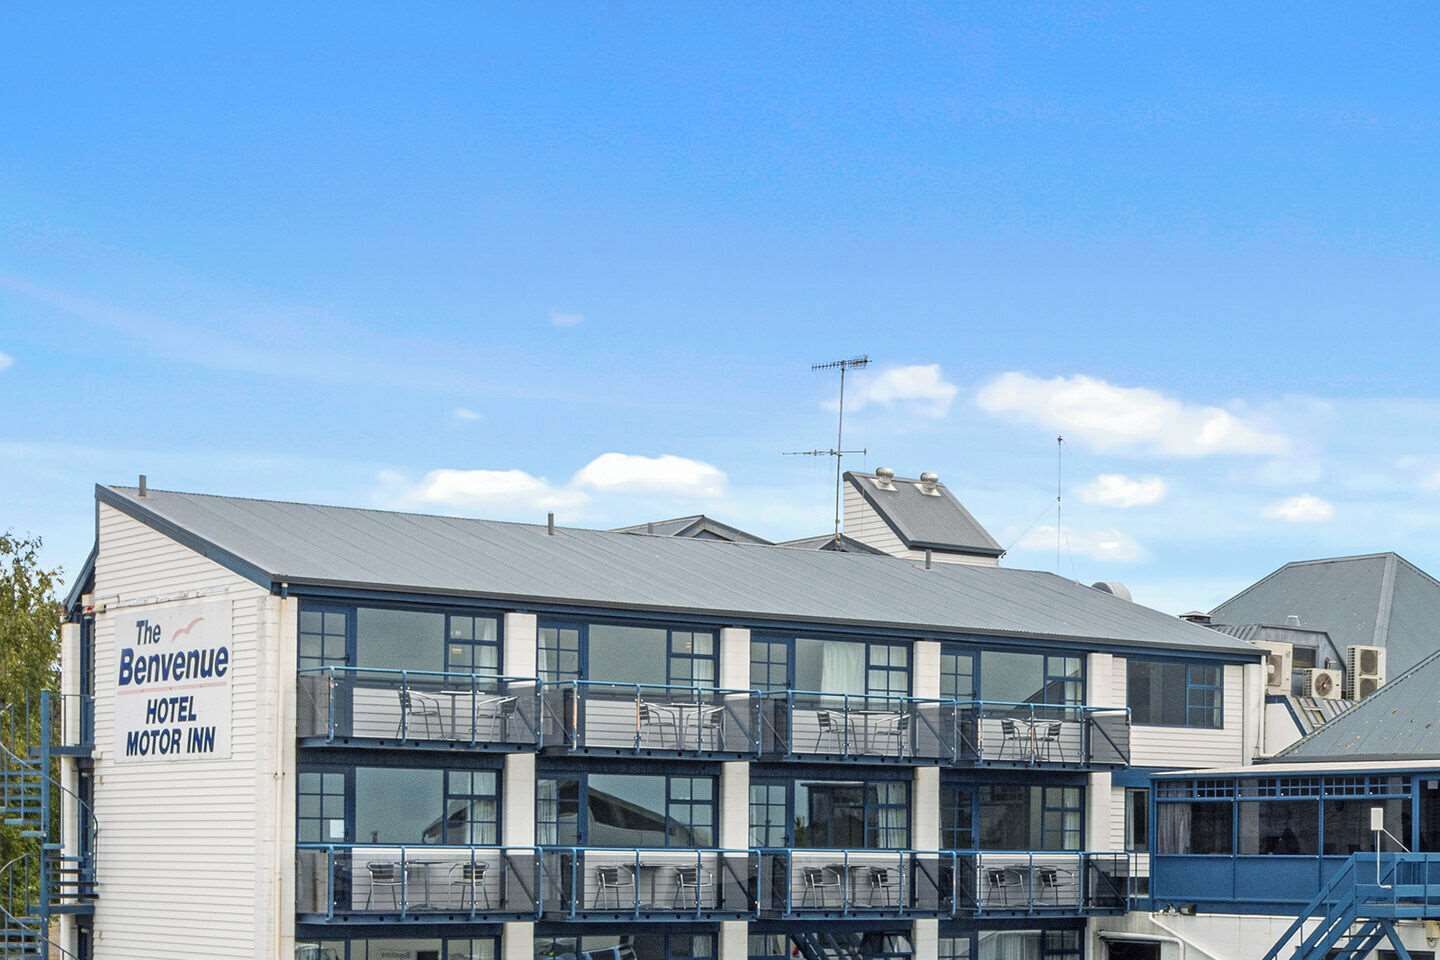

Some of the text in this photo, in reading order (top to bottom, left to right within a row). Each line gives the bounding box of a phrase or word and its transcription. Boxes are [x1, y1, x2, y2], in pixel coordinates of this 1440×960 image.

[136, 619, 161, 646] The
[118, 646, 229, 686] Benvenue
[146, 696, 197, 725] HOTEL
[126, 726, 216, 757] MOTOR INN
